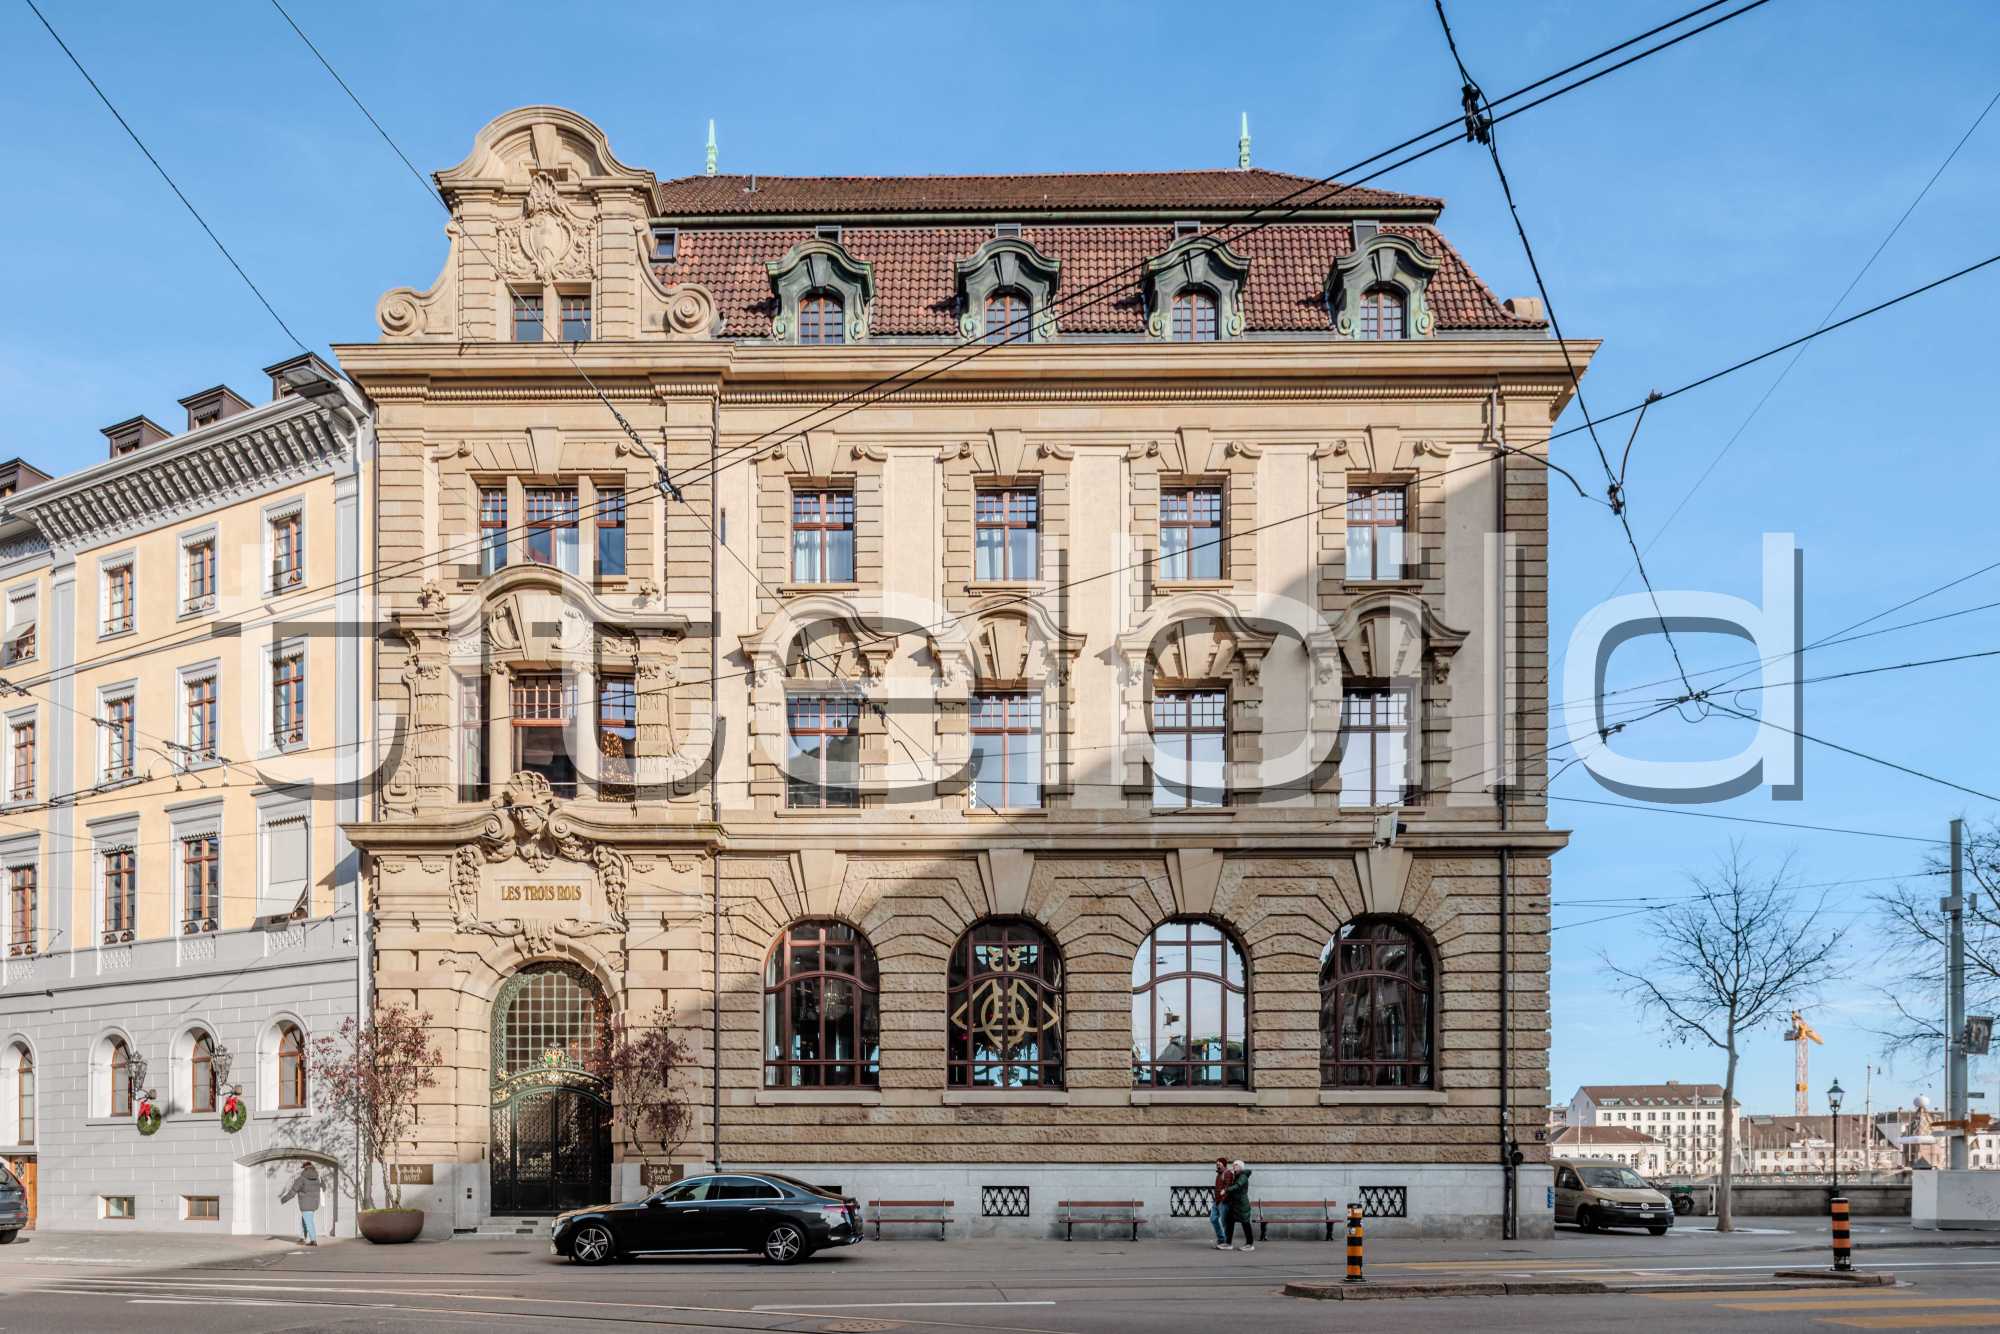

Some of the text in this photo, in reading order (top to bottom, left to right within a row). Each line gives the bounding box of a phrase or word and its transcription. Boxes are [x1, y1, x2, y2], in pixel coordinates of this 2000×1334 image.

[501, 885, 582, 901] LES TROIS ROIS
